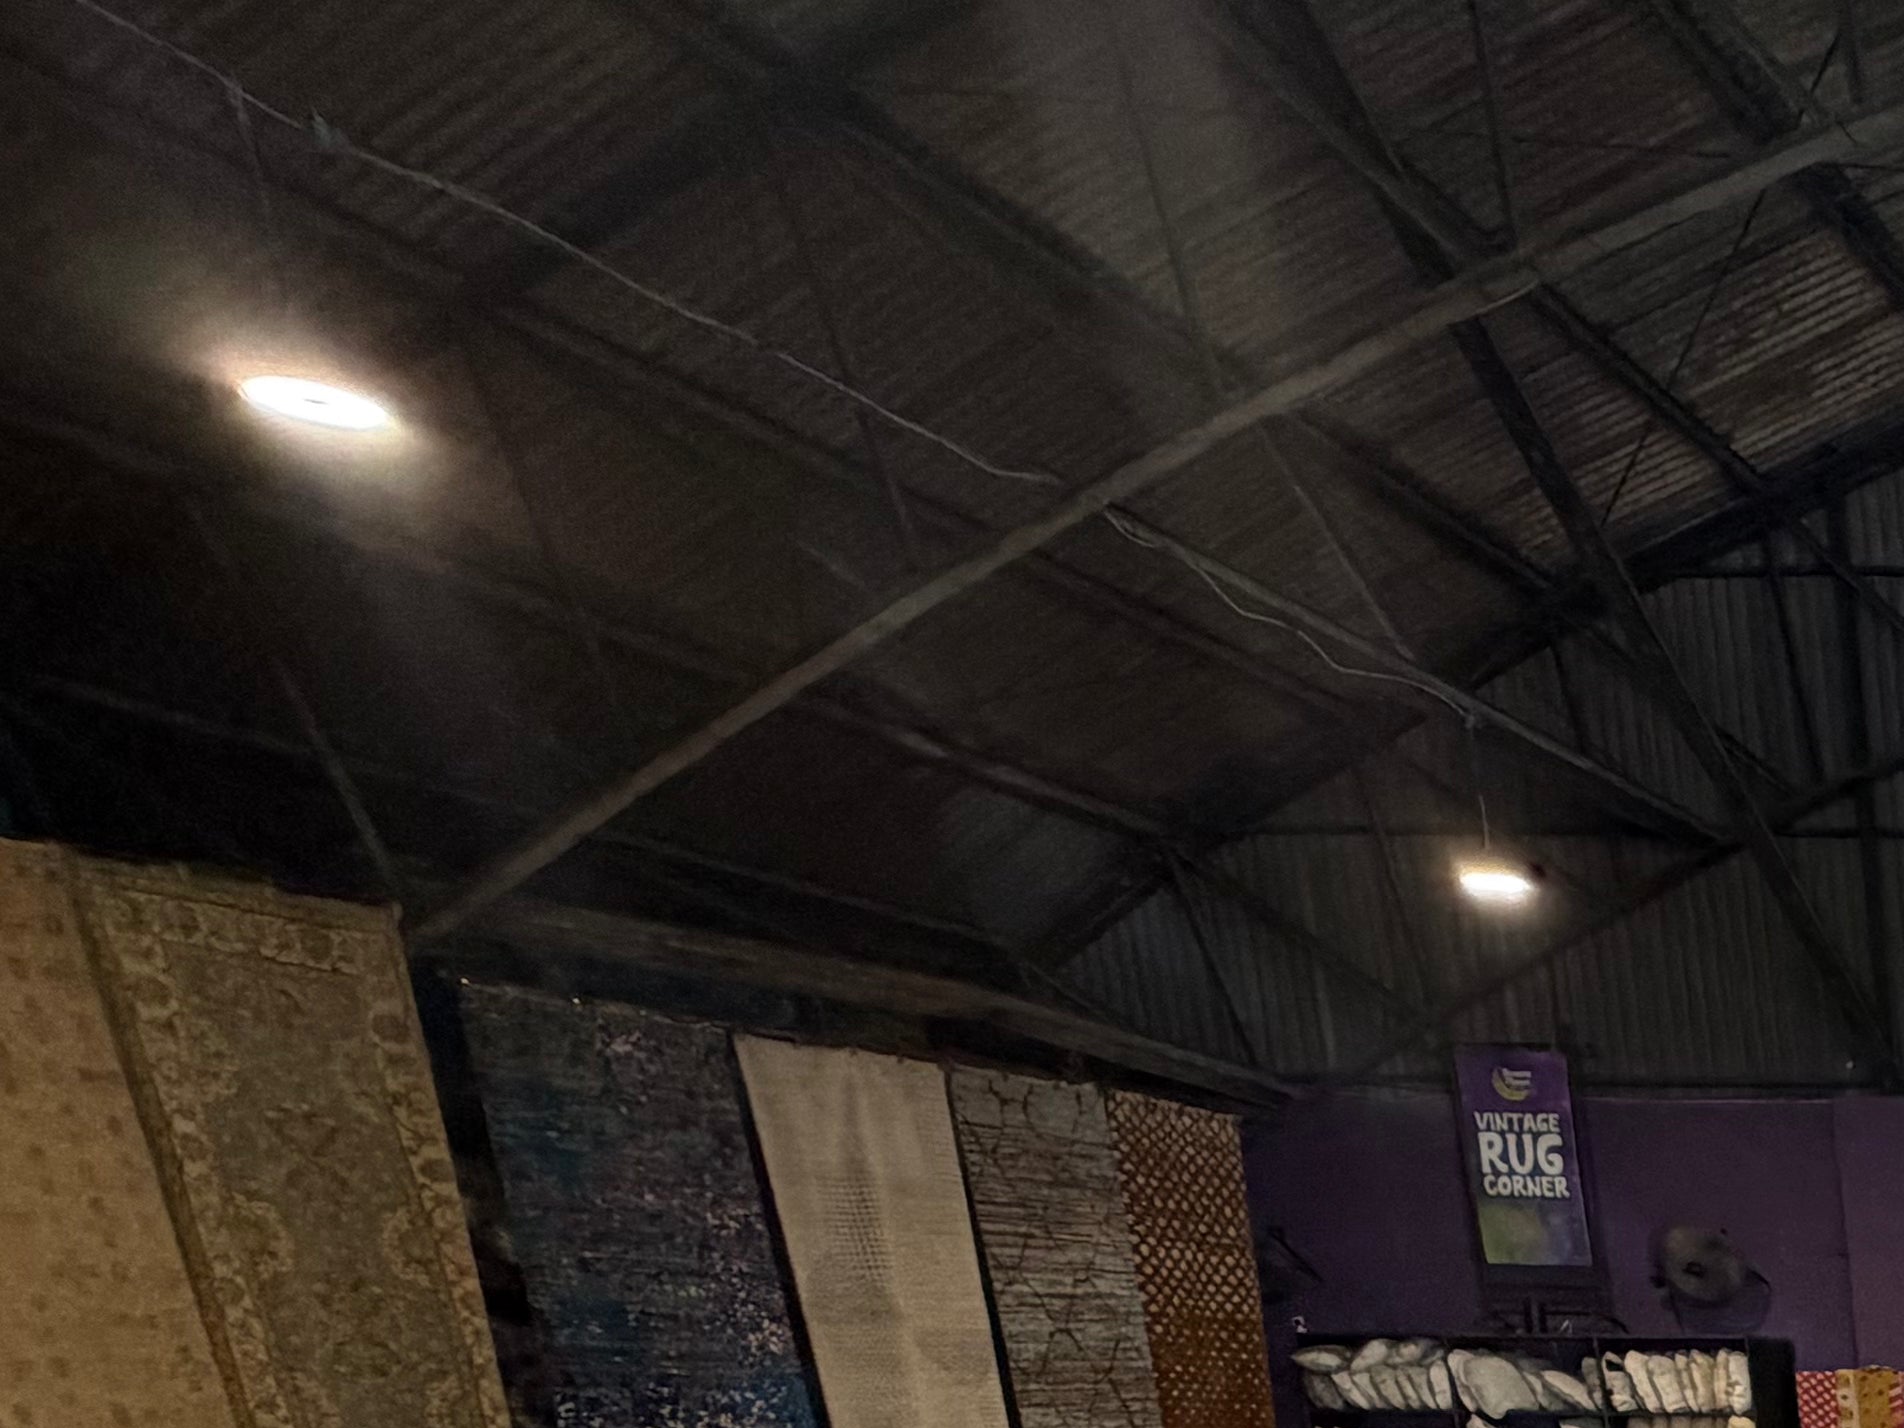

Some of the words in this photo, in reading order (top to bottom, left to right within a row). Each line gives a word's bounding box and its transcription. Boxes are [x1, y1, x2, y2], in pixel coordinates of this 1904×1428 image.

[1473, 1111, 1560, 1133] VINTAGE
[1477, 1131, 1564, 1175] RUG
[1483, 1174, 1571, 1198] CORNER
